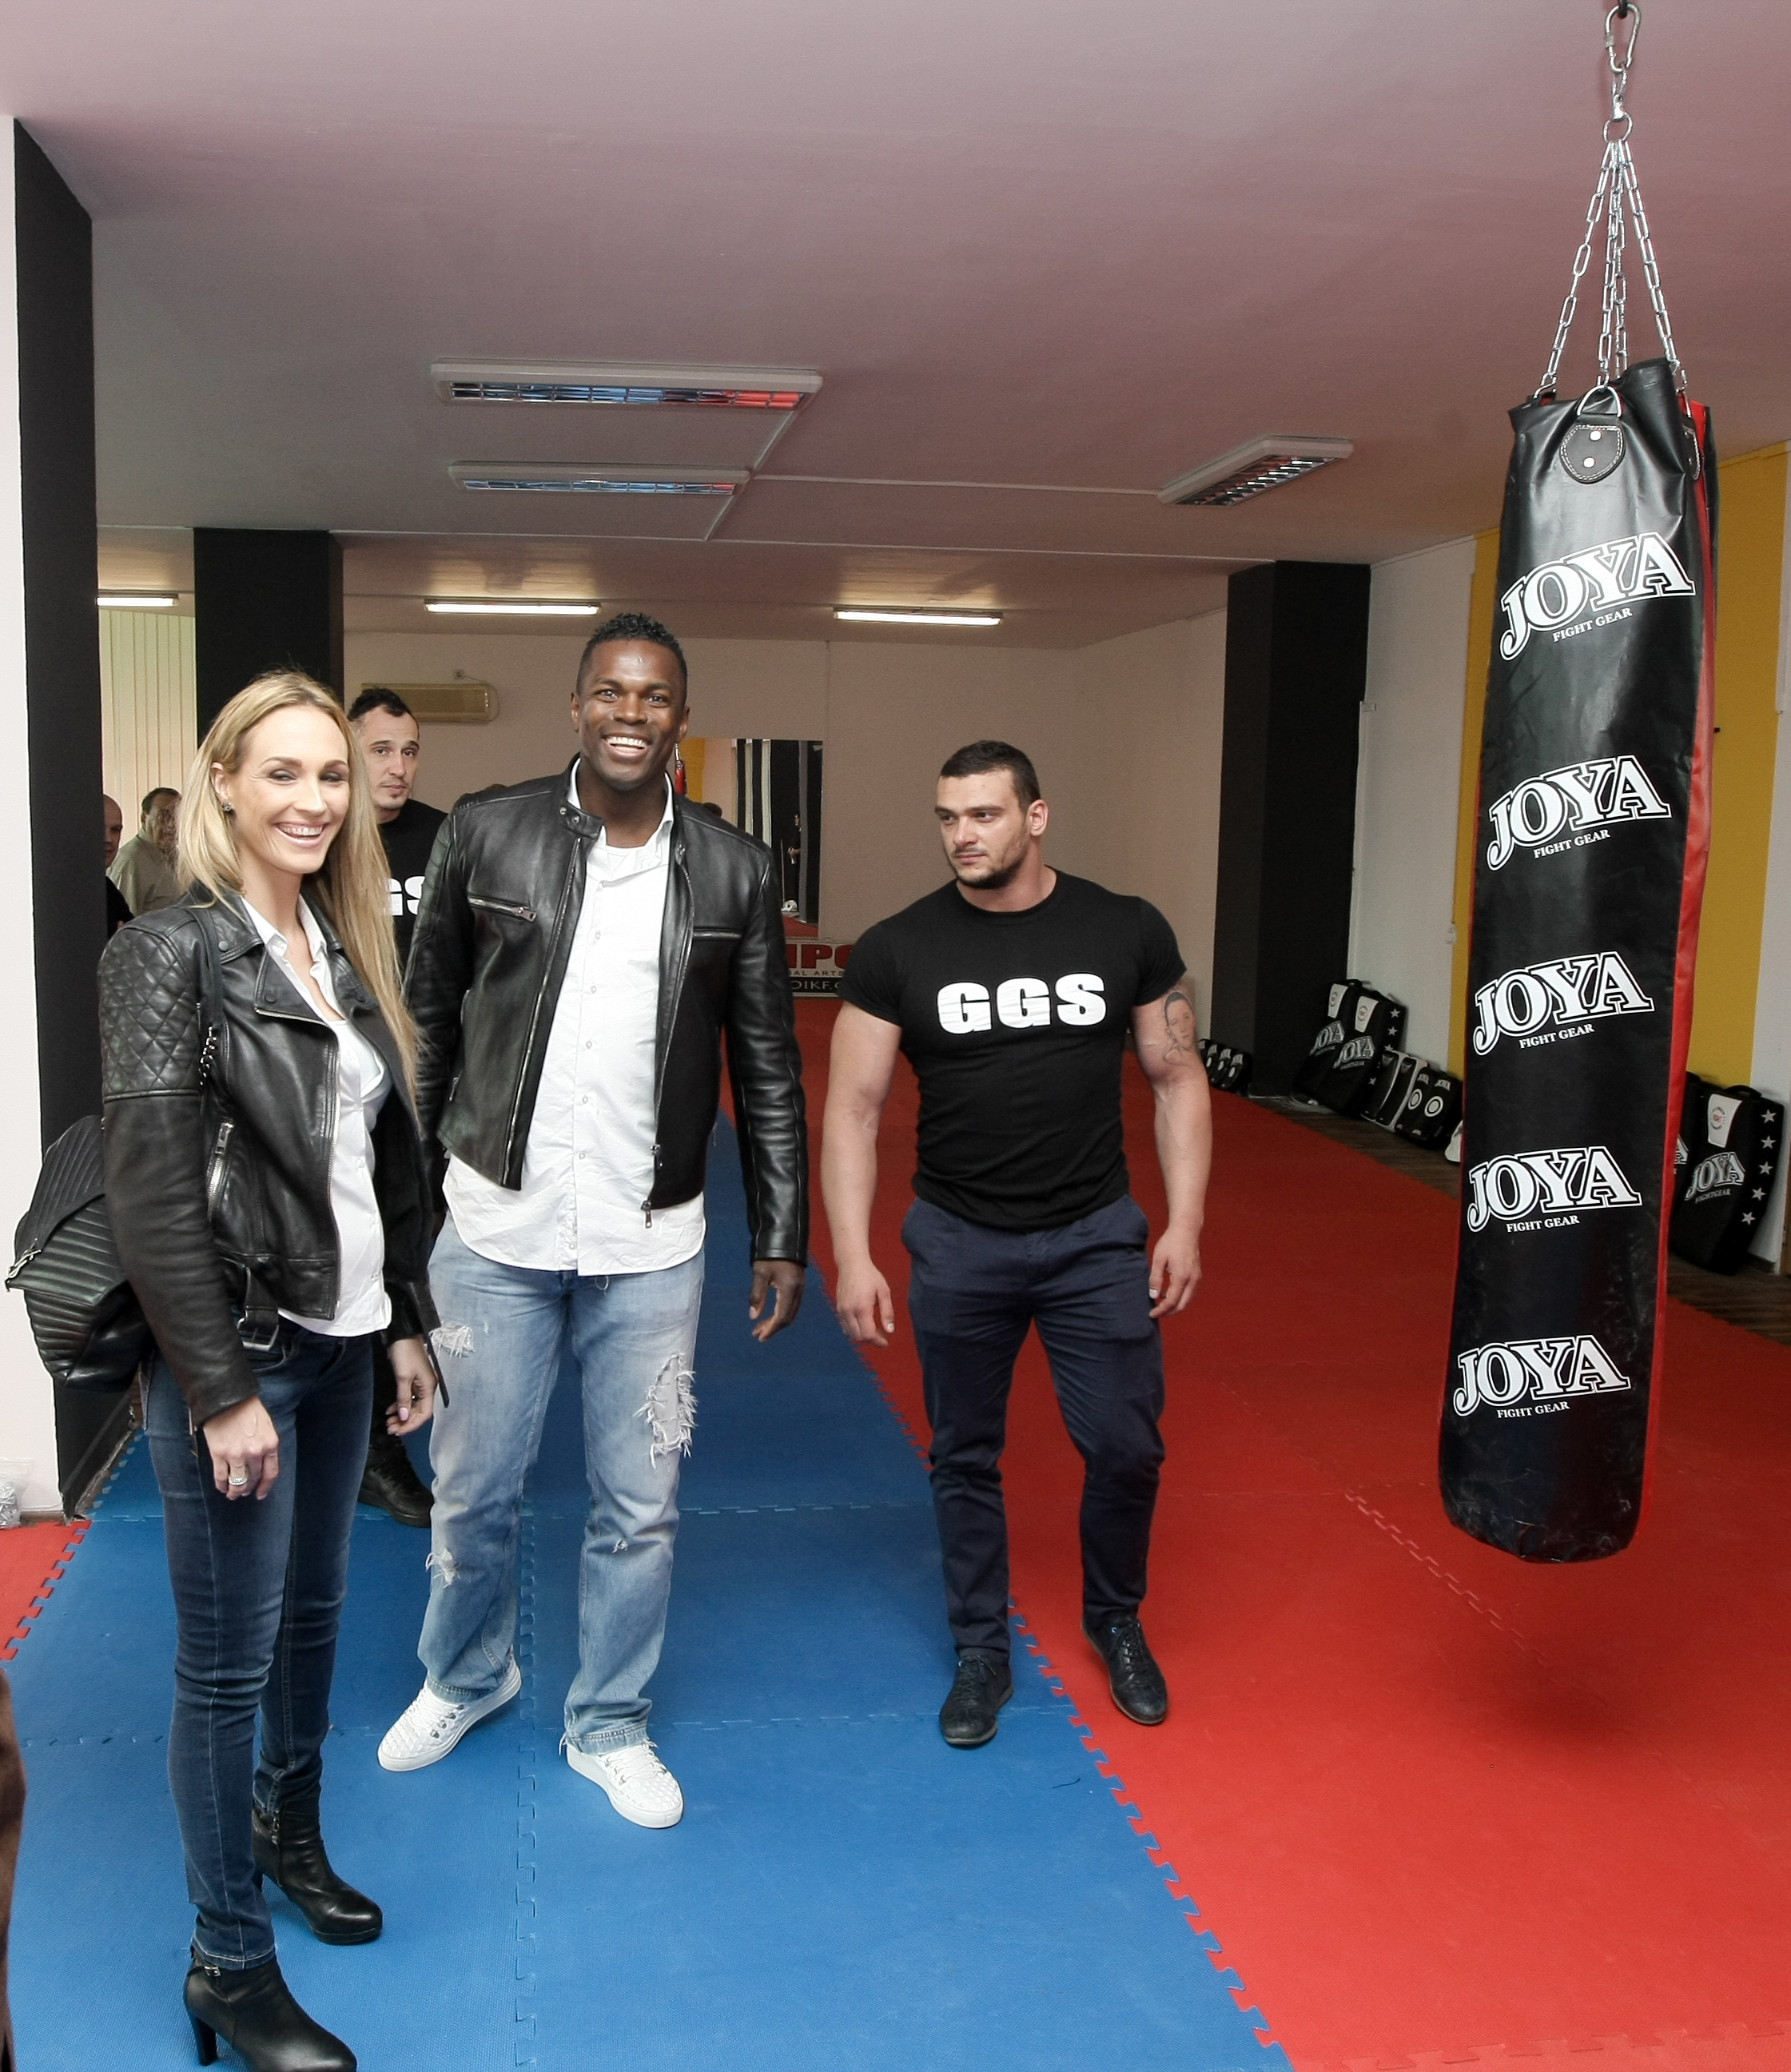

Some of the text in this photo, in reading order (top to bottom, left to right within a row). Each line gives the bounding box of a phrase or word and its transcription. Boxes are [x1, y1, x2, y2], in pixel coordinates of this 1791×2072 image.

[1499, 531, 1696, 661] JOYA
[1552, 606, 1633, 643] FIGHT GEAR
[1487, 755, 1672, 871] JOYA
[1533, 829, 1610, 859] FIGHT GEAR
[937, 973, 1107, 1034] GGS
[1473, 950, 1655, 1056] JOYA
[1332, 1035, 1375, 1069] JOYA
[1518, 1023, 1595, 1049] FIGHT GEAR
[1467, 1146, 1642, 1233] JOYA
[1685, 1151, 1746, 1201] JOYA
[1506, 1215, 1580, 1233] FIGHT GEAR
[1453, 1334, 1632, 1417] JOYA
[1497, 1401, 1570, 1418] FIGHT GEAR
